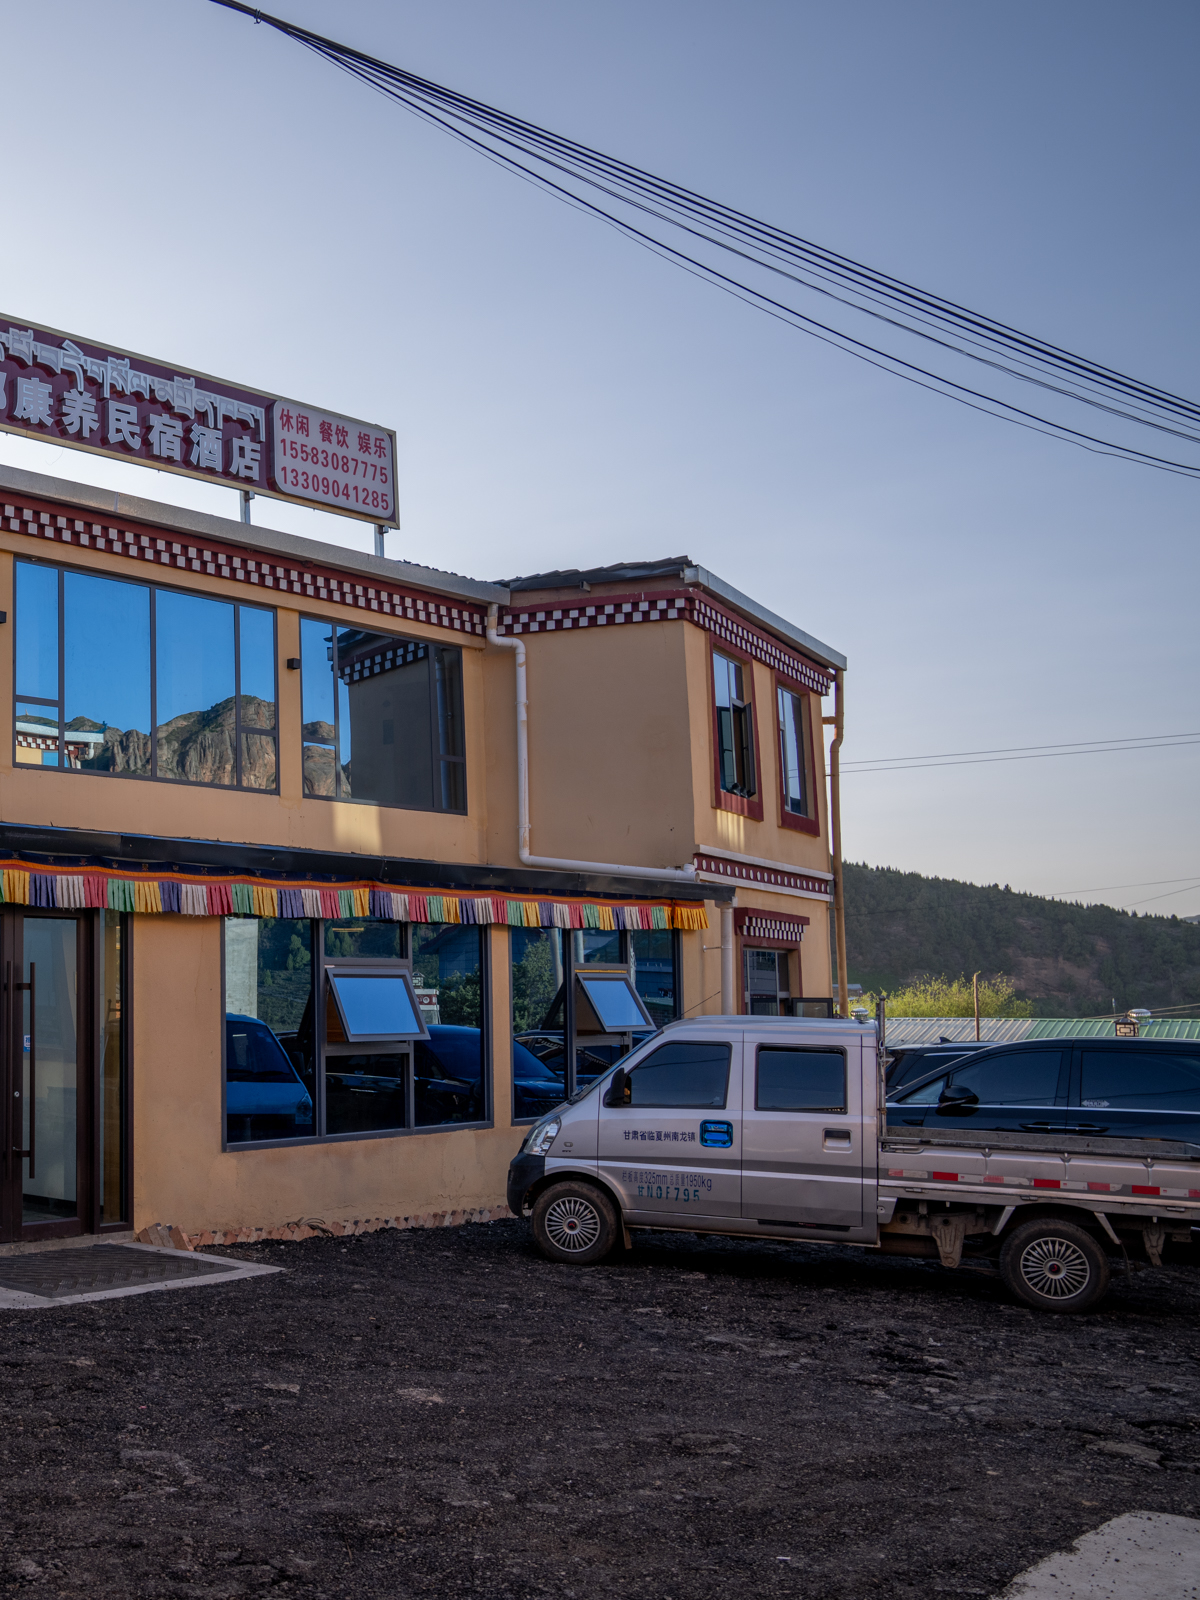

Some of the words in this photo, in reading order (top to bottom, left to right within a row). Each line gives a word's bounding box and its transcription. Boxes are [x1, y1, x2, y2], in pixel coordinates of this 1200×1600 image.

[279, 408, 310, 437] 休闲
[319, 420, 349, 449] 餐饮
[357, 431, 387, 459] 娱乐
[280, 438, 388, 484] 15583087775
[281, 466, 389, 511] 13309041285
[623, 1130, 696, 1142] 甘肃省临夏州南龙镇
